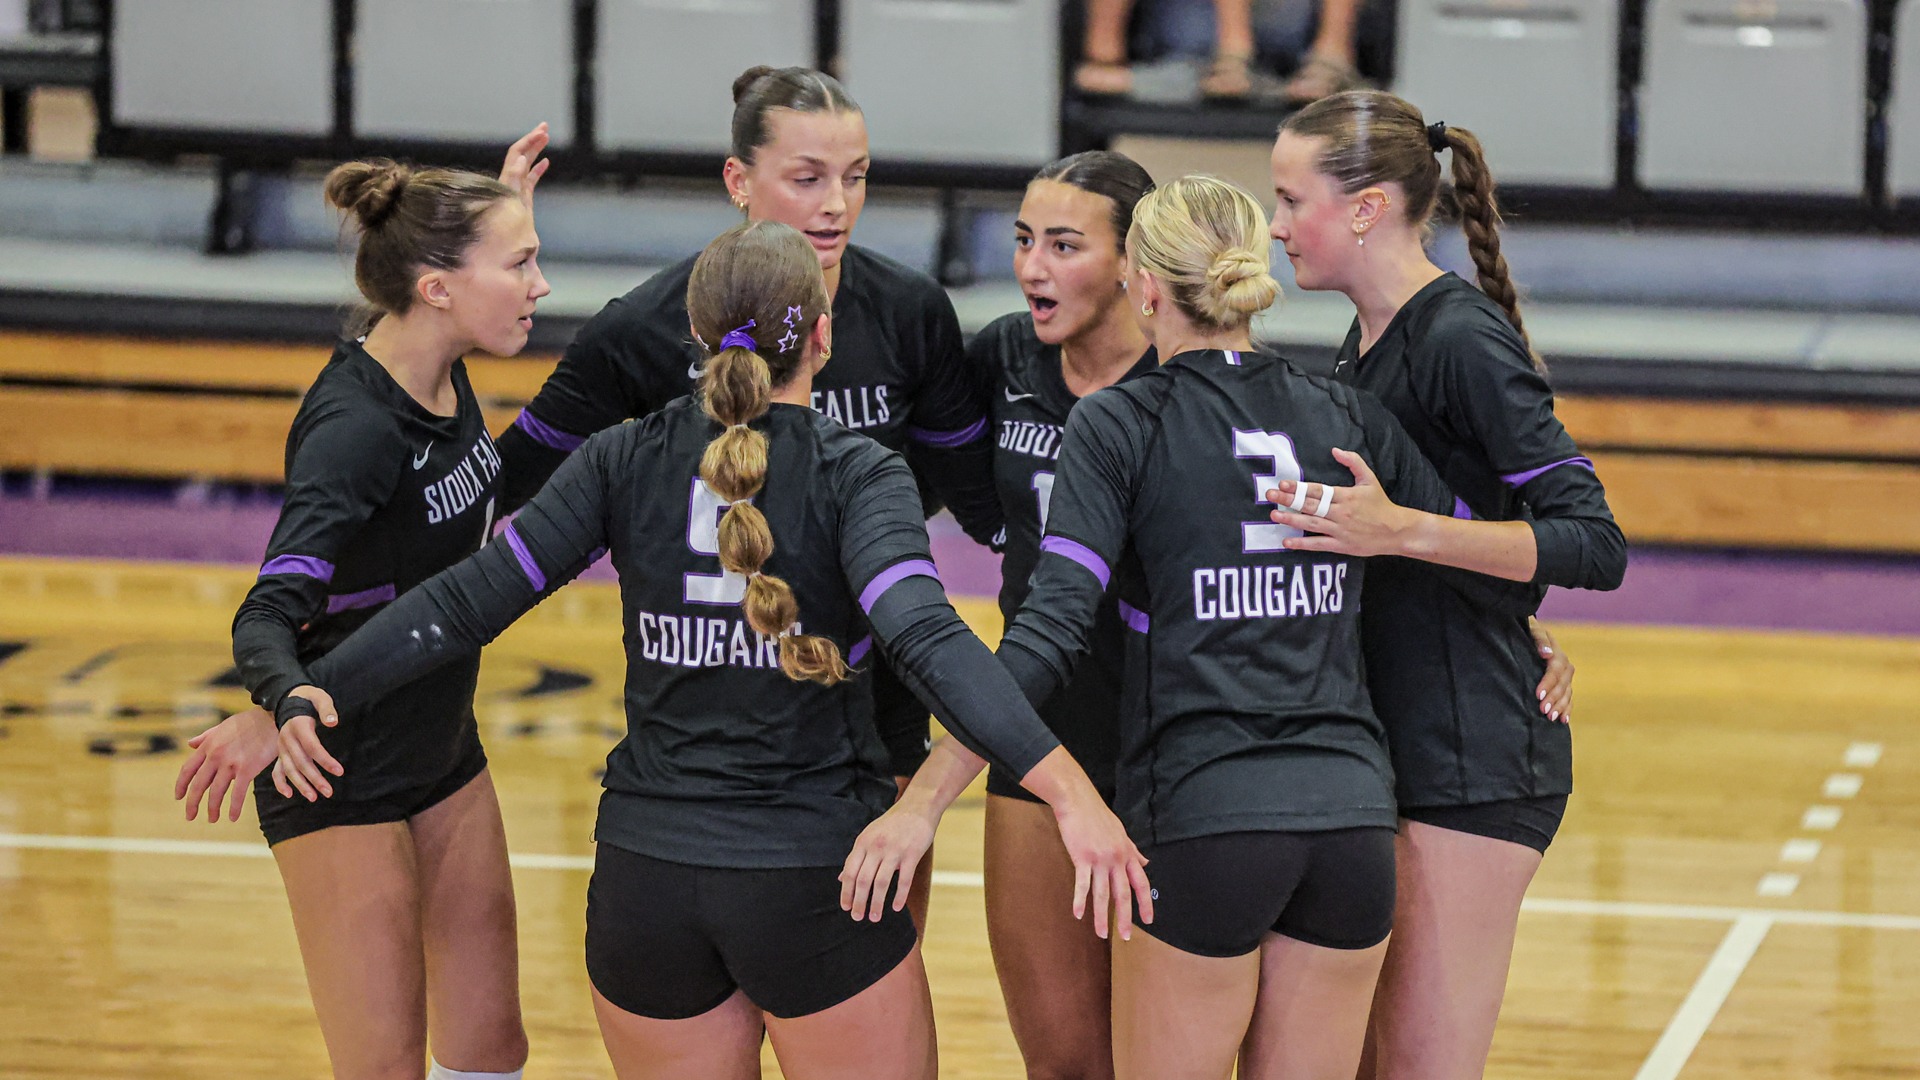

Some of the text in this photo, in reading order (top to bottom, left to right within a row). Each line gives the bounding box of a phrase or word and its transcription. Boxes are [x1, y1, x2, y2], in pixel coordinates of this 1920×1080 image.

[809, 384, 890, 429] FALLS
[423, 429, 502, 524] SIOUX FAL
[1232, 427, 1304, 553] 3
[683, 476, 753, 606] 5
[1193, 562, 1347, 620] COUGARS
[638, 610, 803, 668] COUGAR
